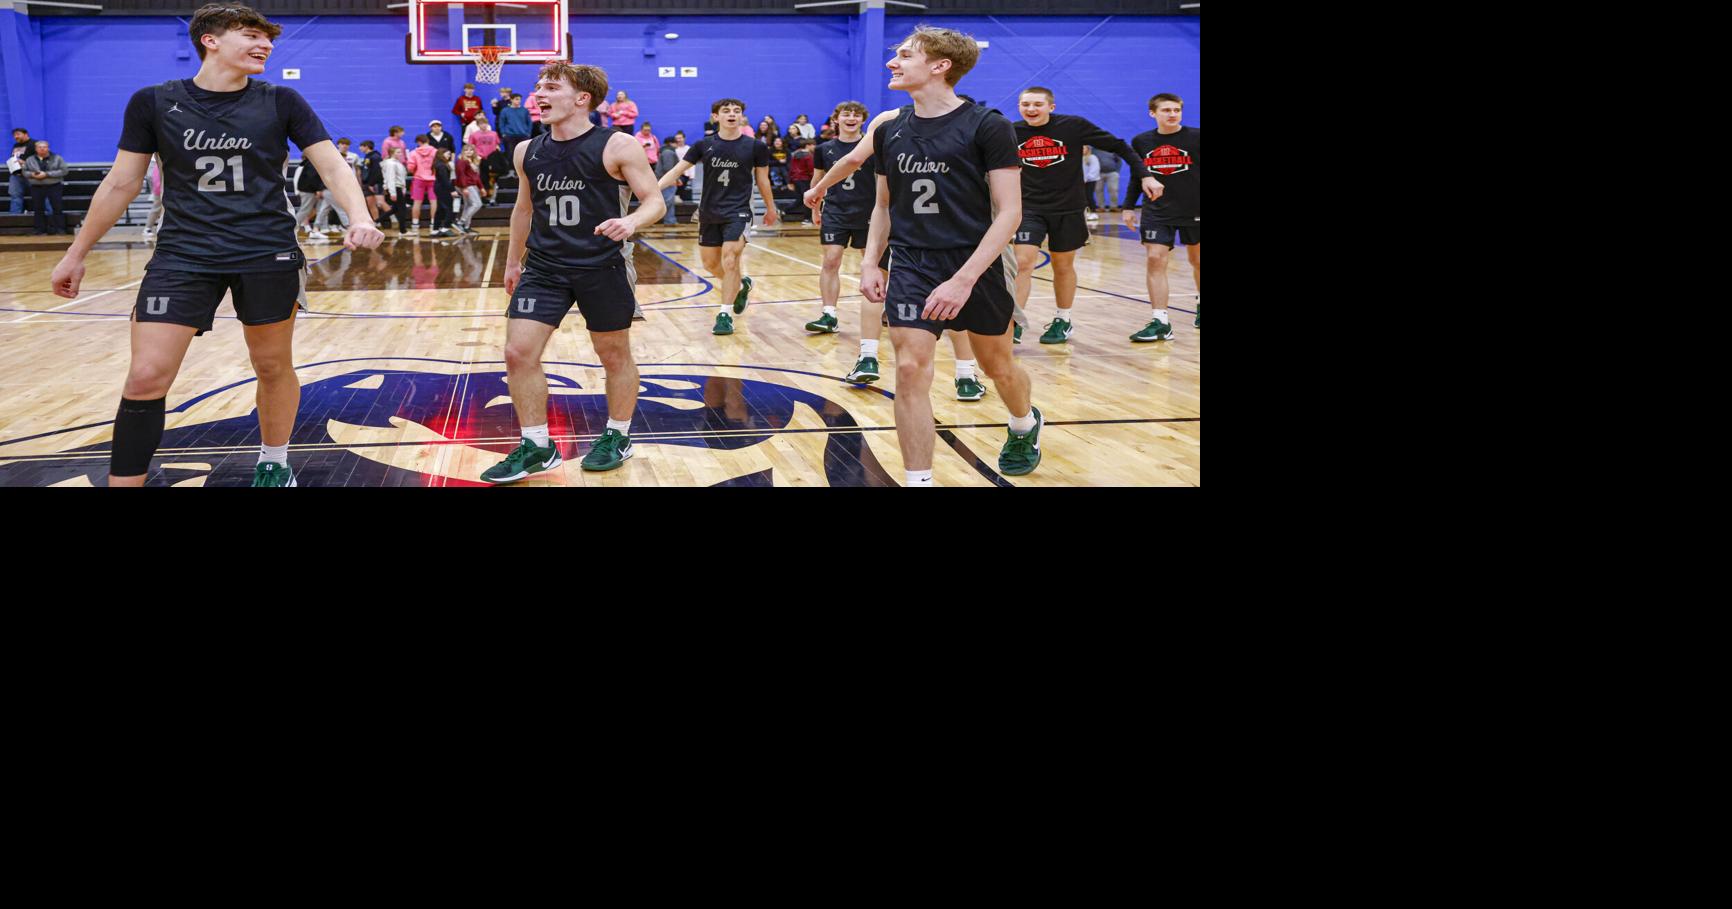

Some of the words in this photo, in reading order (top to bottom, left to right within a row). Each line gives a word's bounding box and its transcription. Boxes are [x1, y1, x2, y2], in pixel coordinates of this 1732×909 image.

[183, 128, 252, 150] Union
[711, 157, 740, 168] Union
[897, 152, 950, 173] Union
[195, 155, 245, 192] 21
[537, 173, 586, 191] Union
[717, 169, 730, 187] 4
[911, 178, 940, 214] 2
[545, 195, 580, 226] 10
[146, 296, 170, 315] U
[517, 297, 537, 314] U
[897, 303, 918, 321] U
